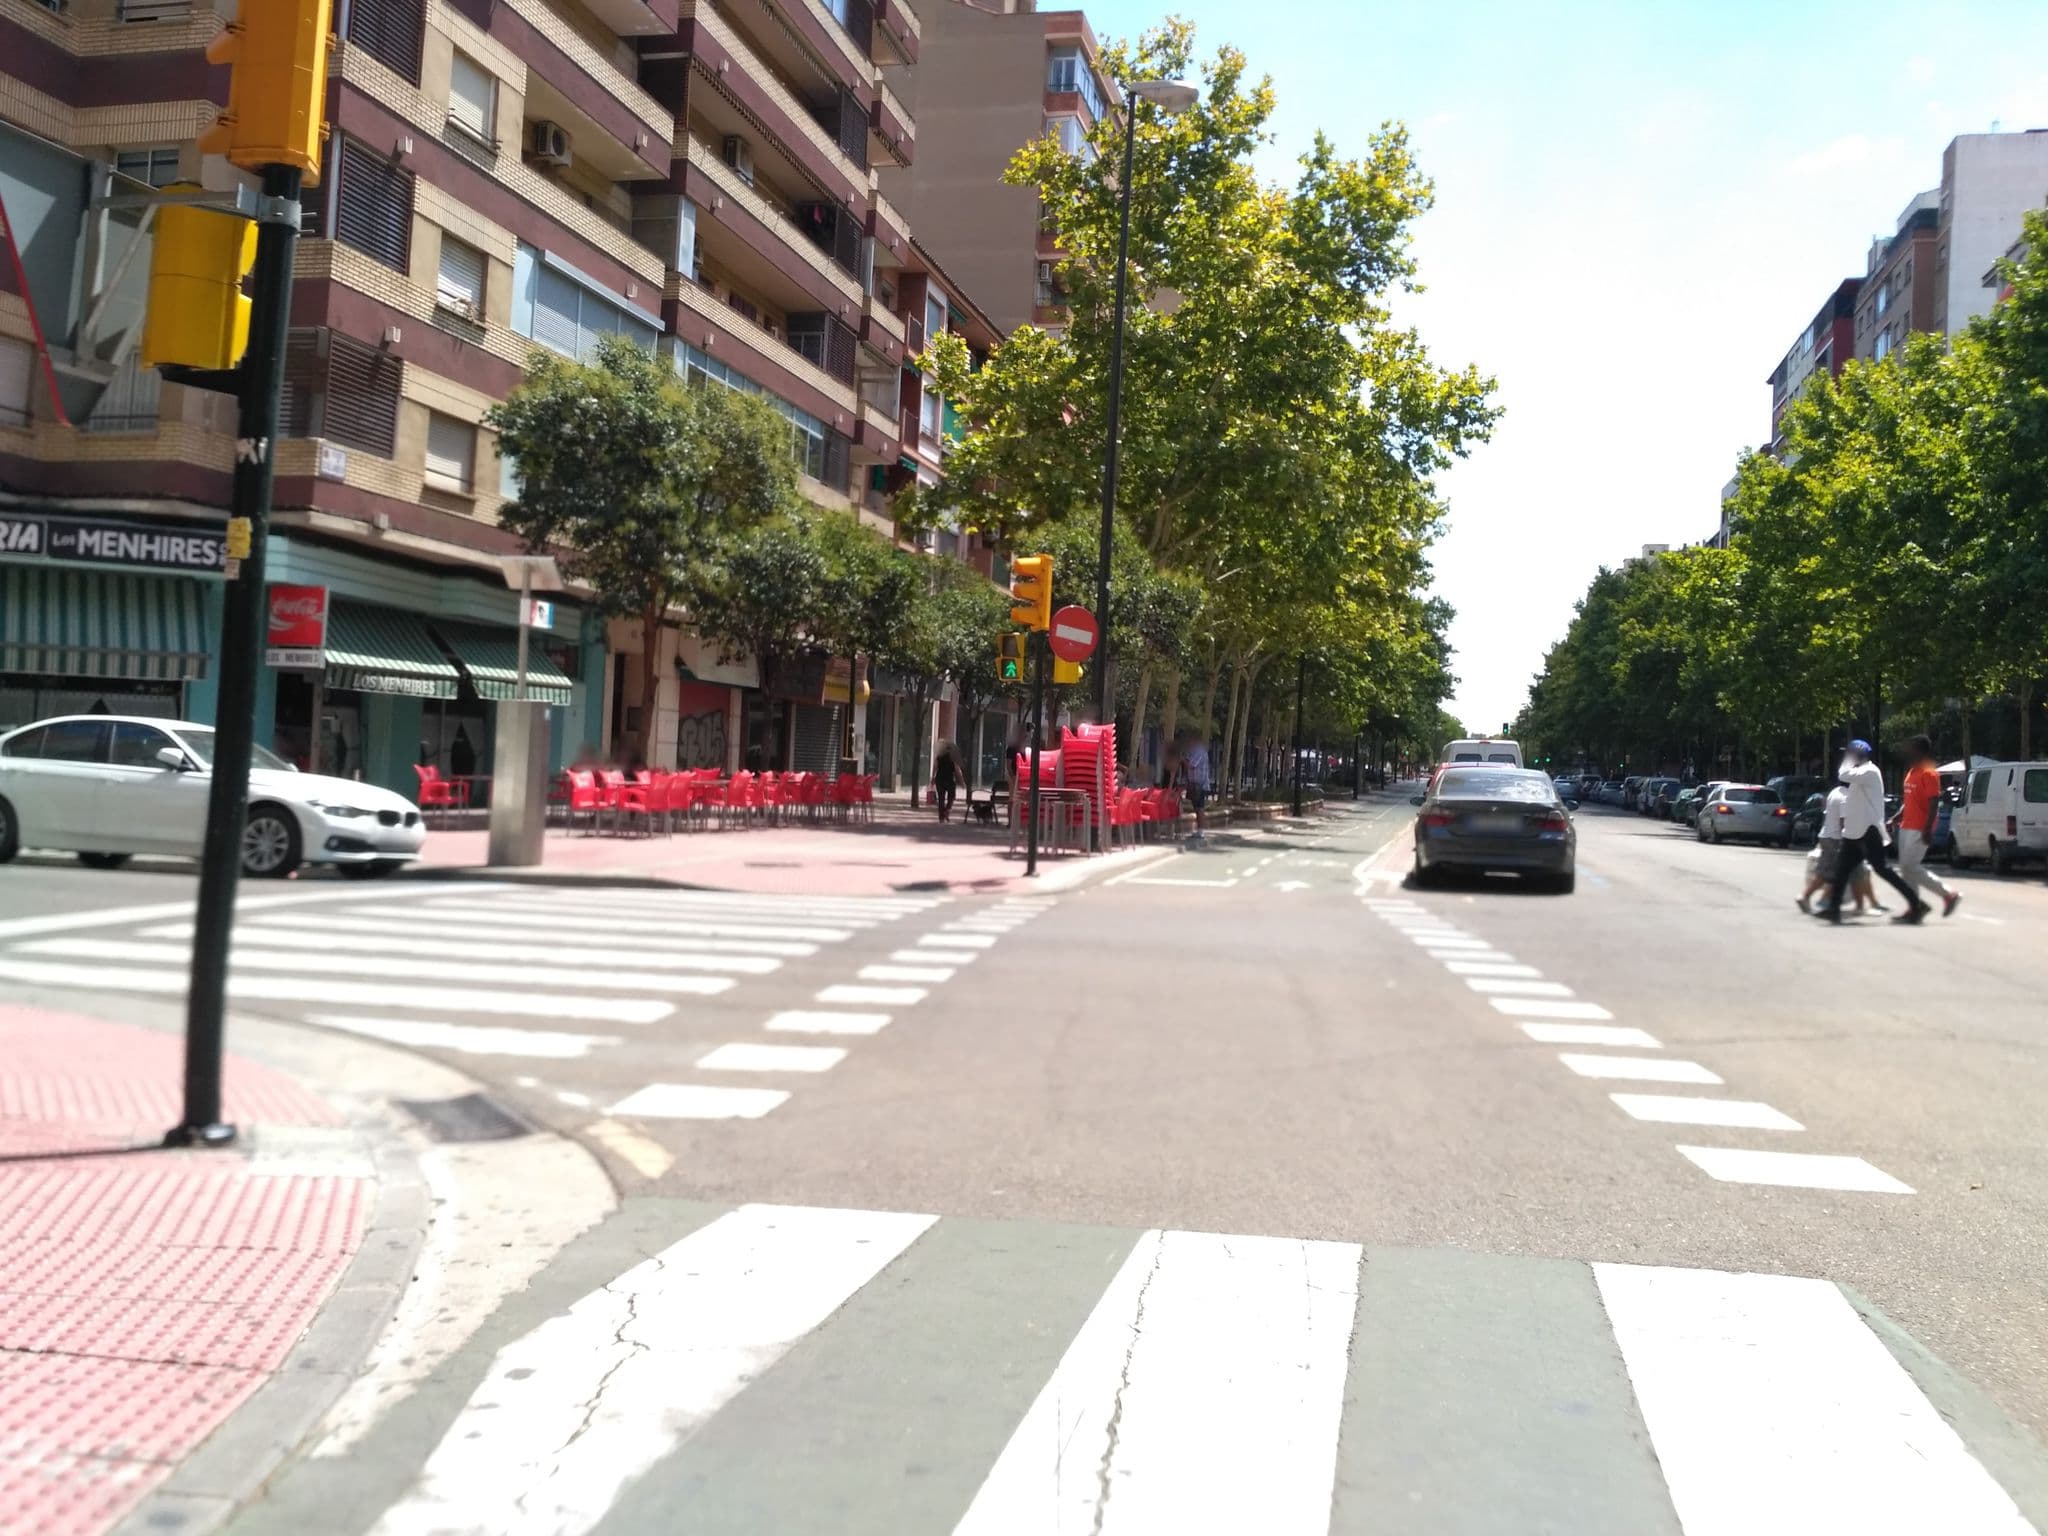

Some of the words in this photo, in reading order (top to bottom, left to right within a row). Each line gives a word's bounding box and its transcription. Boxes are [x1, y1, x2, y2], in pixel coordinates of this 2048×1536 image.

[77, 528, 218, 566] MENHIRES
[352, 673, 377, 690] LOS
[377, 675, 436, 695] MENHIRES
